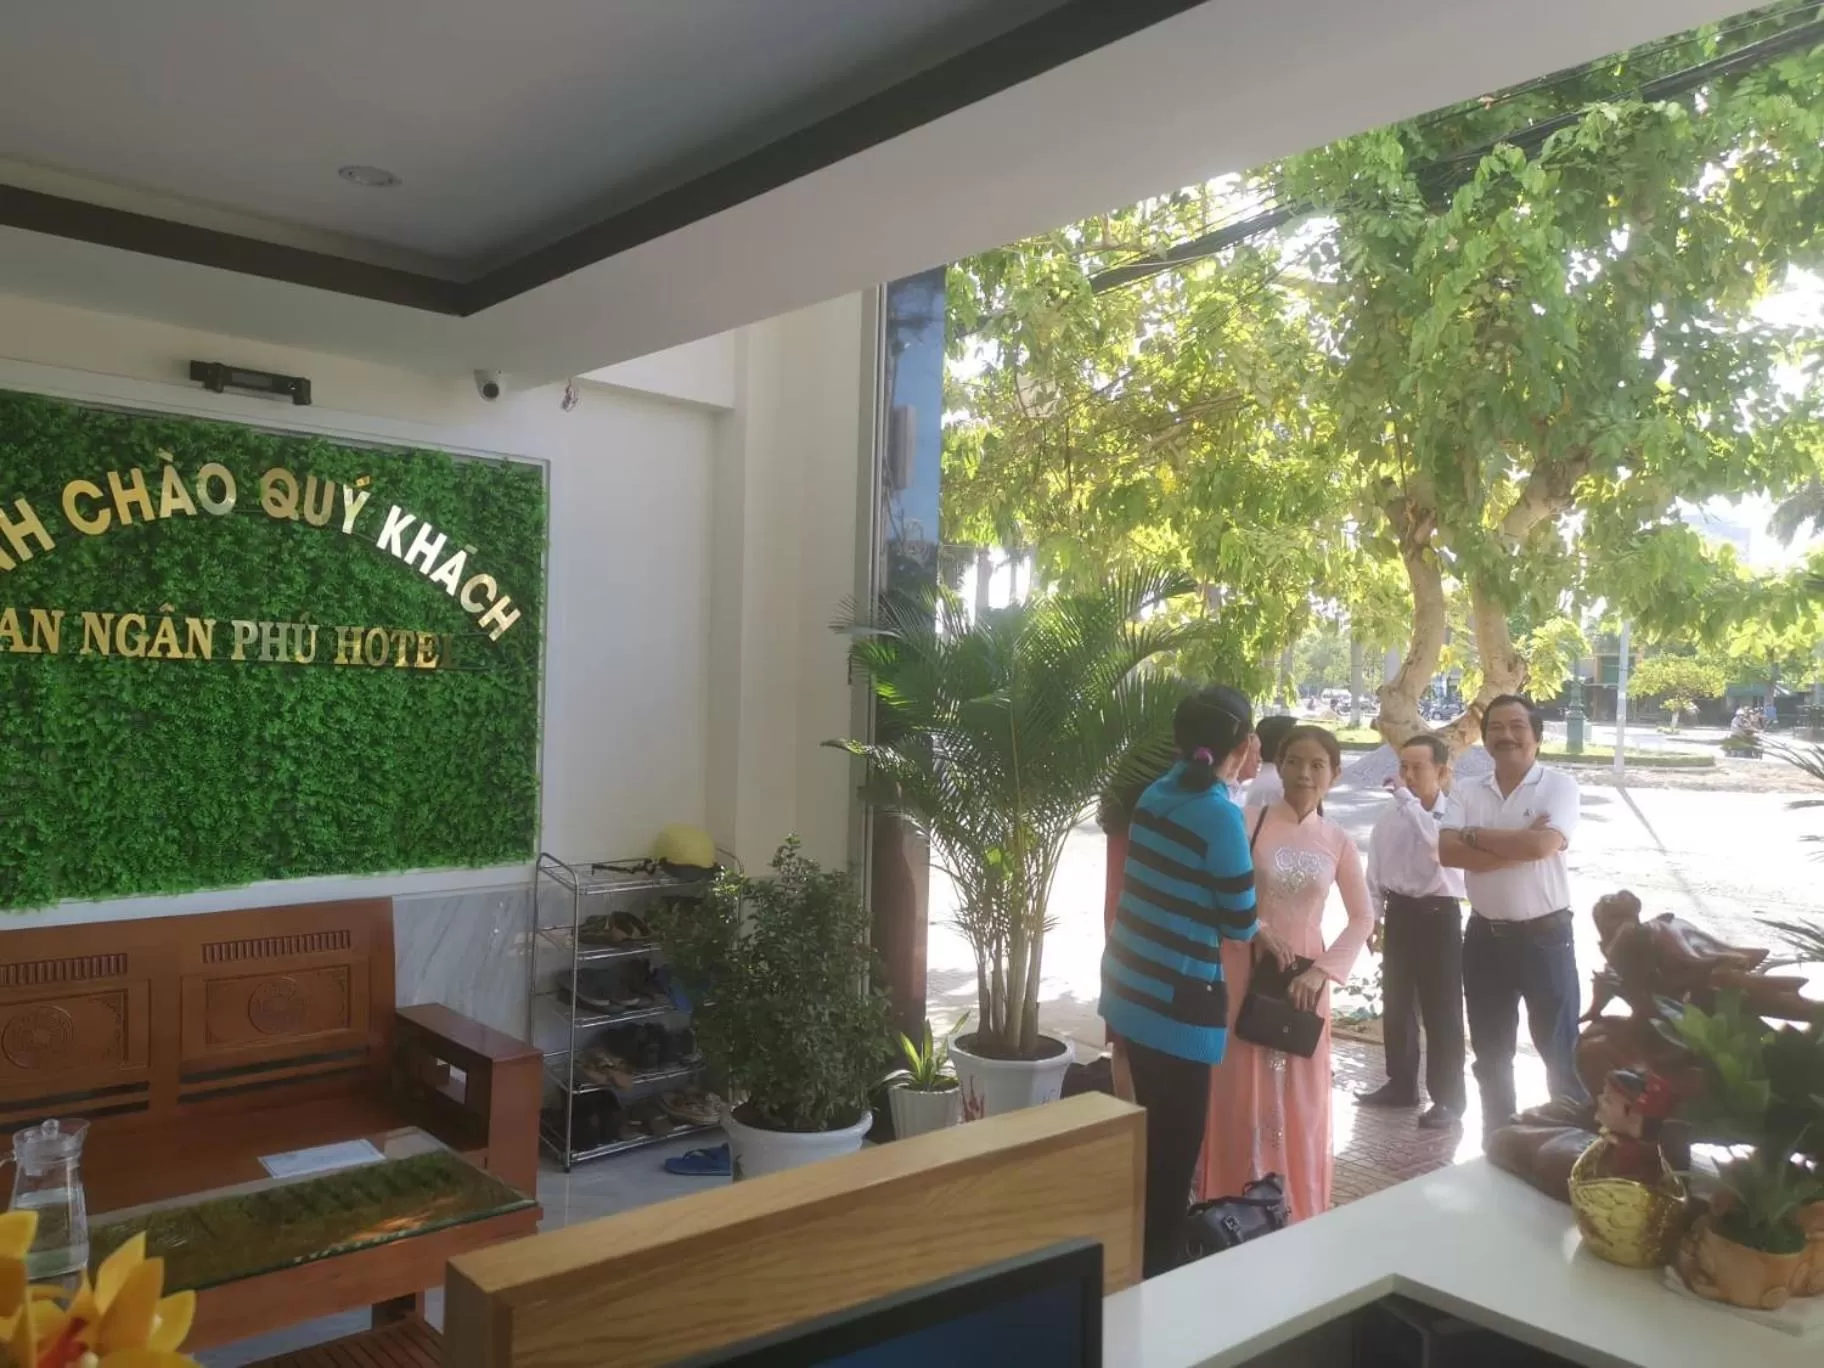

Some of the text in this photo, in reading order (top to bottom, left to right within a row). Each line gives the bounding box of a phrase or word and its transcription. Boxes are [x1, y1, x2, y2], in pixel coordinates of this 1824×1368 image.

[62, 448, 237, 535] CHÀO
[260, 467, 371, 535] QUÝ
[376, 504, 521, 642] KHÁCH
[79, 603, 216, 660] NGÂN
[230, 611, 319, 664] PHÚ
